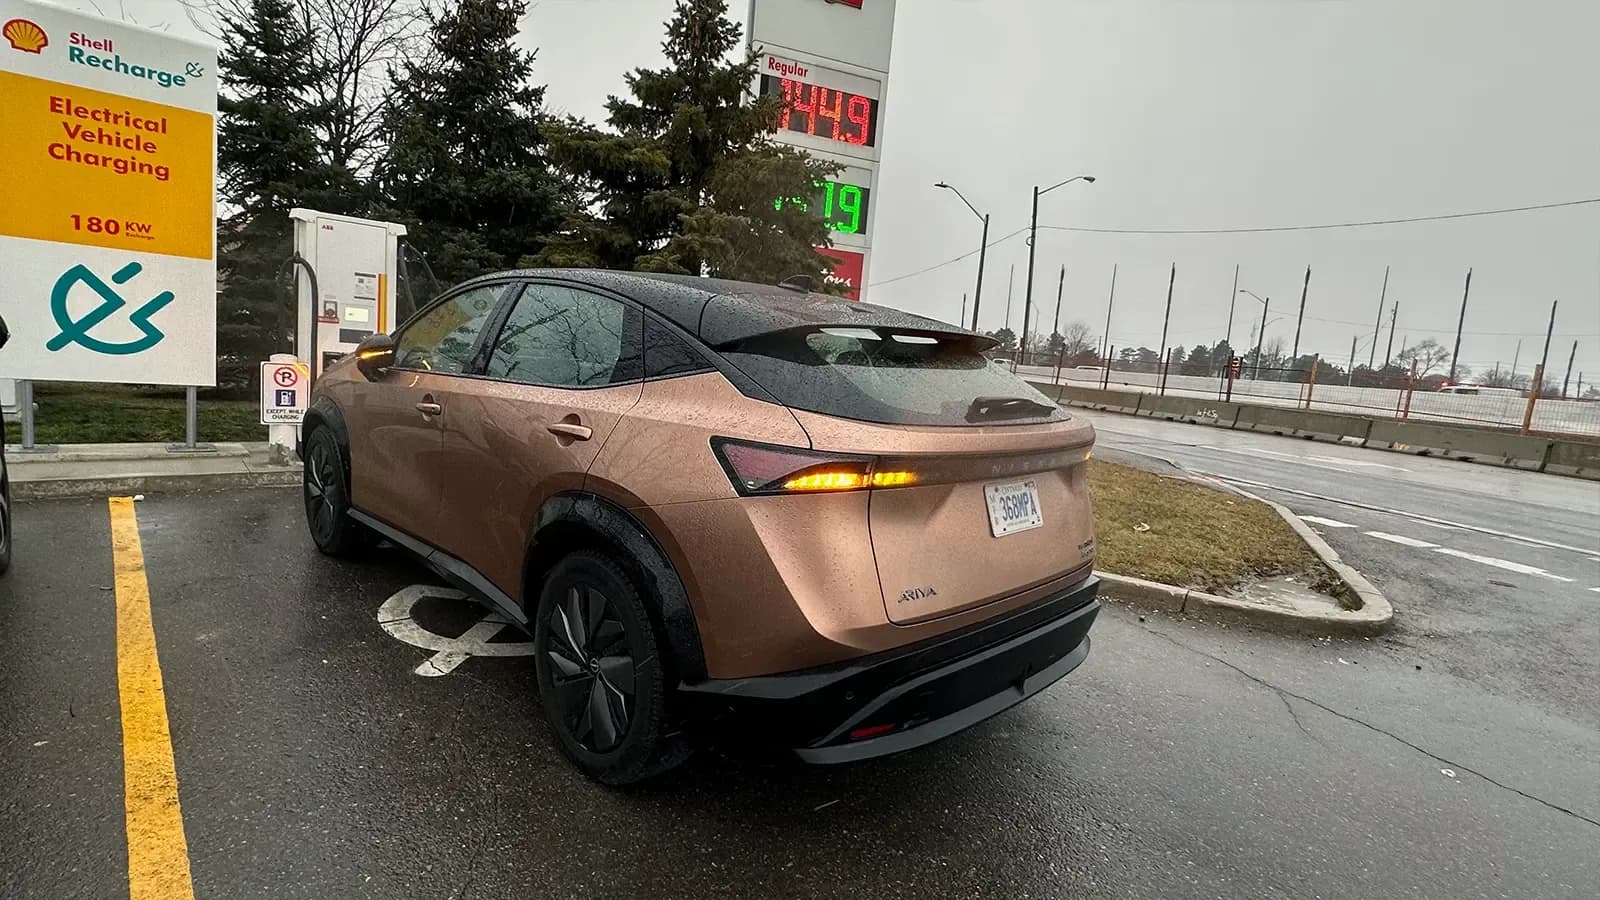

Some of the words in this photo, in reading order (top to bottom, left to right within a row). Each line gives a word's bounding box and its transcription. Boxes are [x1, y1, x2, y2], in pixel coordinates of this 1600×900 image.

[70, 32, 113, 53] Shell
[68, 46, 186, 88] Recharge
[768, 56, 808, 78] Regular
[49, 95, 167, 135] Electrical
[61, 121, 158, 154] Vehicle
[48, 142, 170, 182] Charging
[70, 214, 120, 235] 180
[125, 221, 152, 234] KW
[999, 491, 1038, 522] 368MPA
[897, 587, 937, 603] ARIYA
